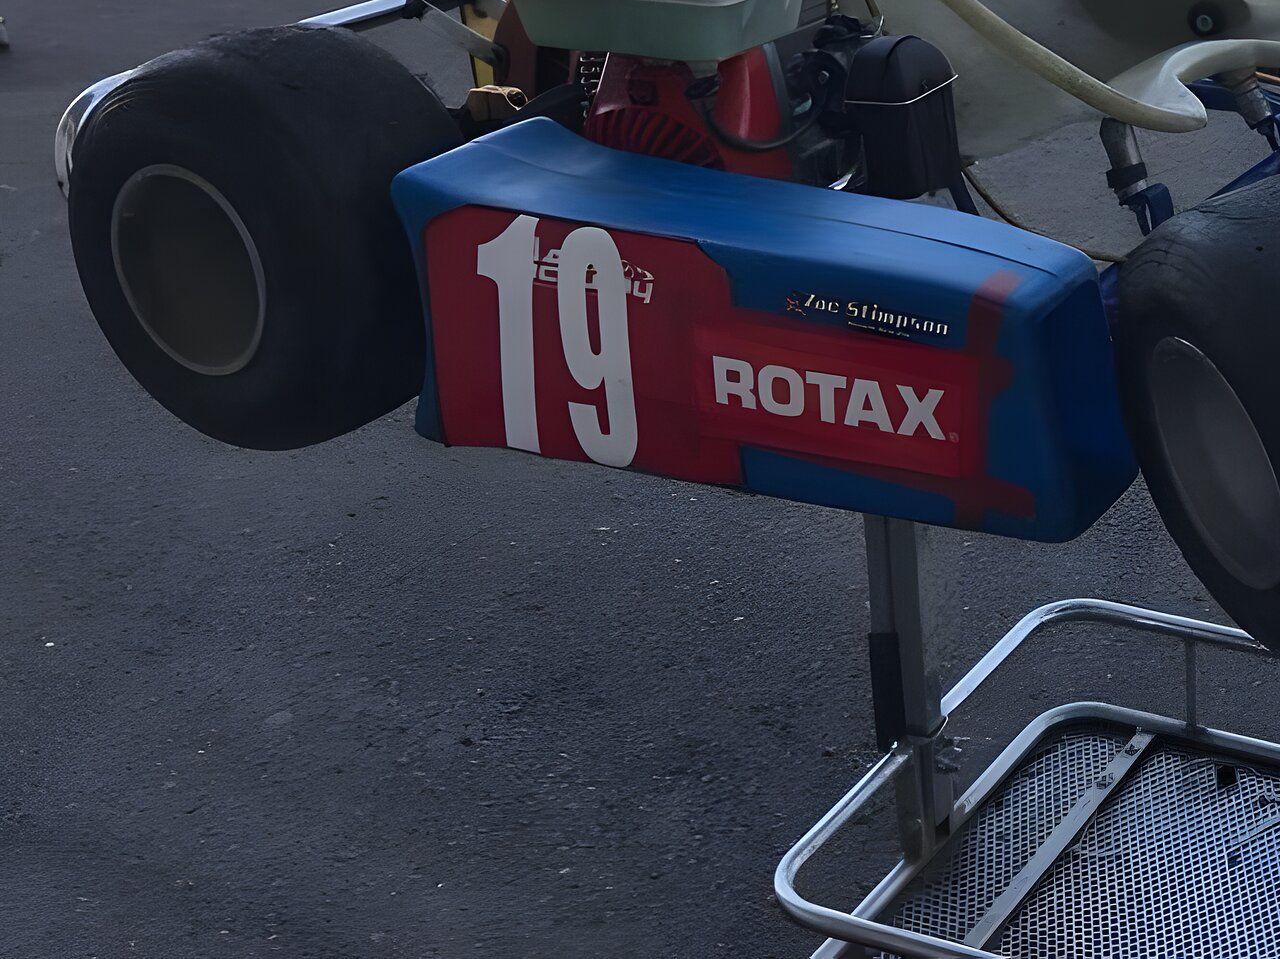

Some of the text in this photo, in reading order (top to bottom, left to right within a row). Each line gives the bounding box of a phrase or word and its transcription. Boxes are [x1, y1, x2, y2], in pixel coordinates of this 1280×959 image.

[477, 214, 638, 468] 19
[846, 300, 949, 336] Stimpson
[711, 355, 947, 441] ROTAX
